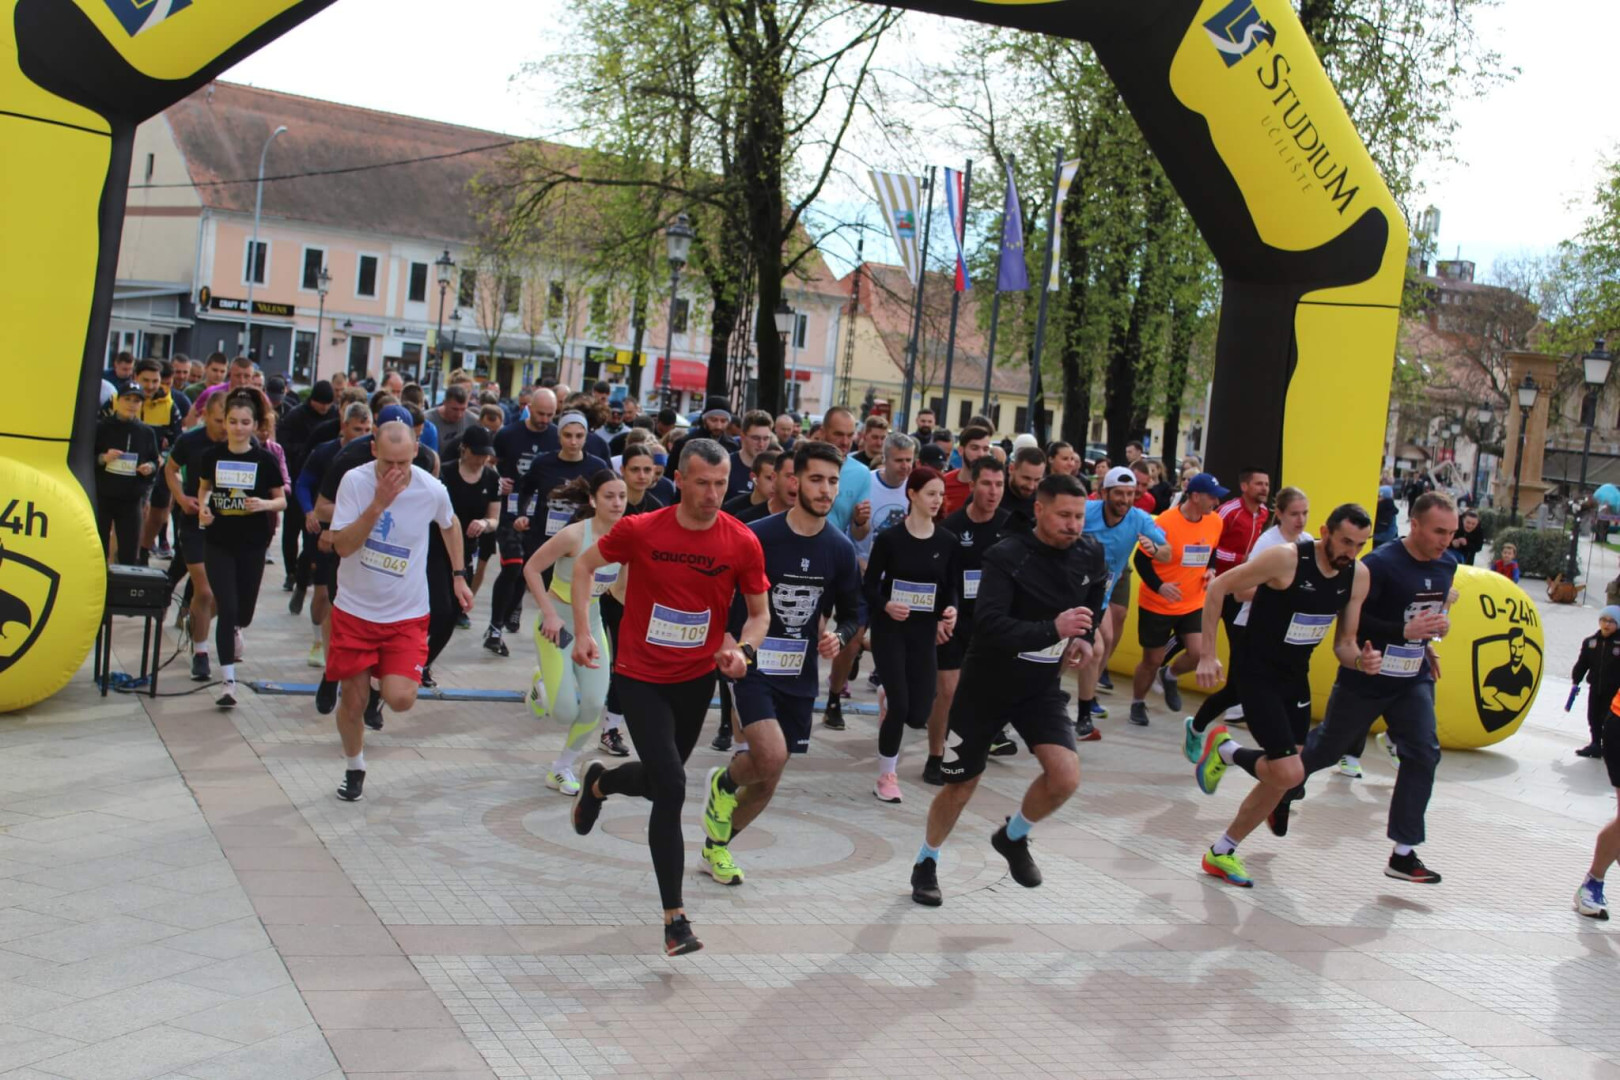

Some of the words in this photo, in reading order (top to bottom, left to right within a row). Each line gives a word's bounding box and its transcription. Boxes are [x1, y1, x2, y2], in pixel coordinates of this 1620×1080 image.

[1261, 115, 1313, 193] UČILIŠTE
[257, 303, 288, 315] VALENS
[236, 472, 255, 484] 129
[382, 556, 407, 573] 049
[651, 549, 716, 568] saucony
[911, 594, 934, 606] 045
[1479, 593, 1538, 628] 0-24h
[680, 625, 707, 641] 109
[780, 654, 804, 668] 073
